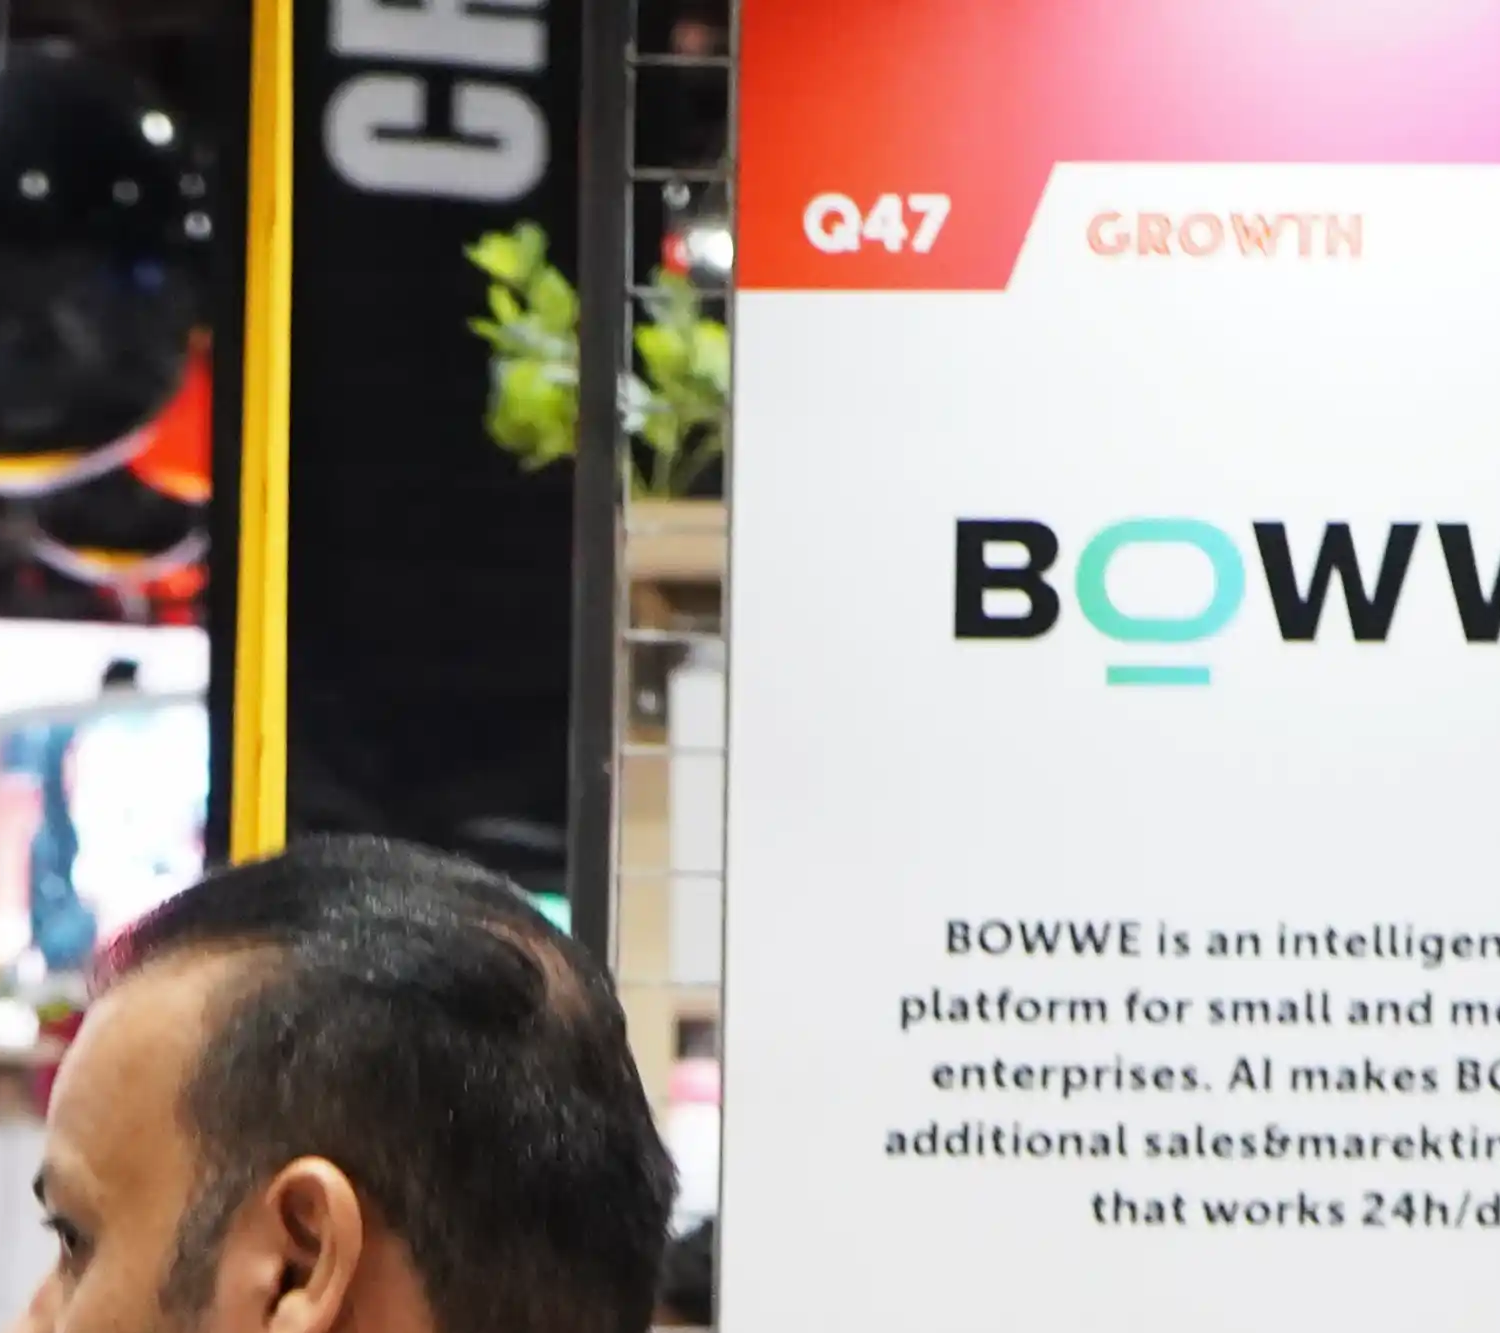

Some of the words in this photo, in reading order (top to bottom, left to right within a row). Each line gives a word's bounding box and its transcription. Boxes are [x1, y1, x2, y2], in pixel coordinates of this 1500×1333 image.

[803, 192, 952, 254] Q47
[1085, 209, 1363, 259] GROWTH
[946, 920, 1138, 956] BOWWE
[1157, 923, 1191, 957] is
[1206, 932, 1261, 957] an
[900, 987, 1108, 1031] platform
[1125, 990, 1190, 1024] for
[1208, 991, 1331, 1025] small
[1347, 991, 1433, 1026] and
[931, 1058, 1211, 1100] enterprises.
[1228, 1057, 1272, 1091] AI
[1290, 1058, 1438, 1093] makes
[885, 1122, 1128, 1158] additional
[1091, 1190, 1186, 1224] that
[1202, 1191, 1345, 1226] works
